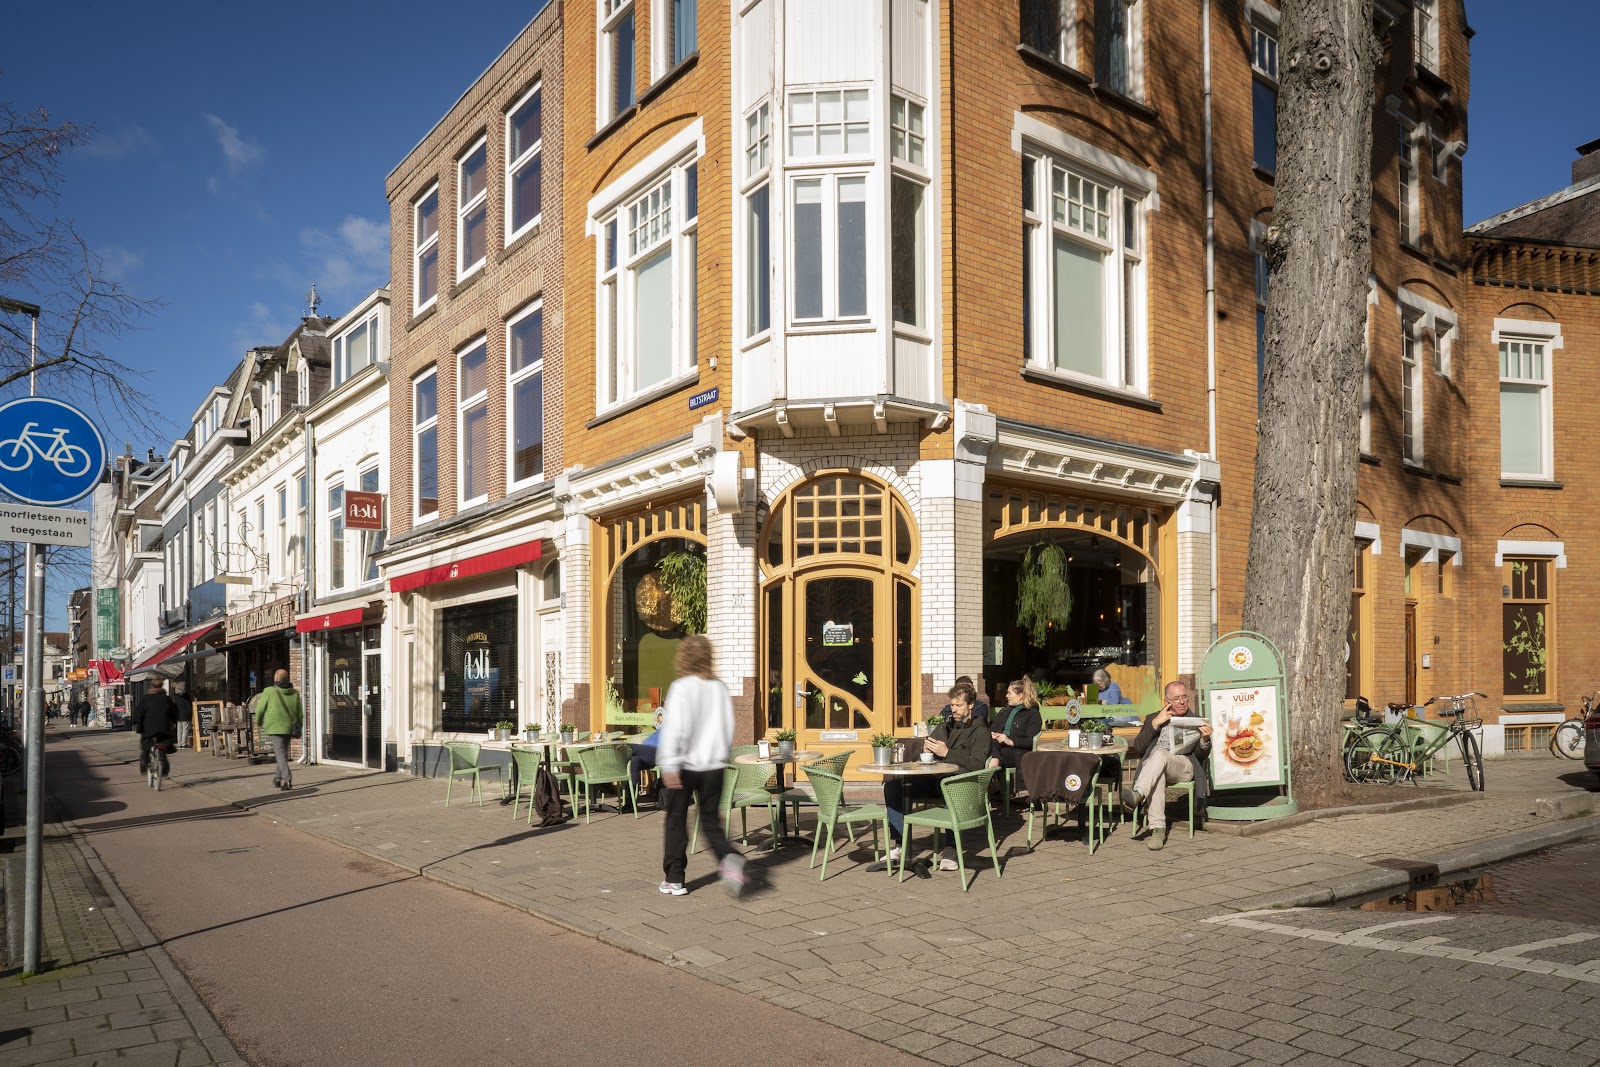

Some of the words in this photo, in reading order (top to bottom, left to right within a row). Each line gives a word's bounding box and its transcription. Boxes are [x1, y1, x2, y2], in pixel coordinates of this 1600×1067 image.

[690, 390, 717, 407] BILTSTRAAT
[0, 511, 61, 523] snorfietsen
[66, 516, 87, 525] niet
[350, 504, 377, 519] Asli
[11, 525, 73, 538] toegestaan
[464, 648, 490, 680] Asli
[1233, 694, 1255, 702] VUUR
